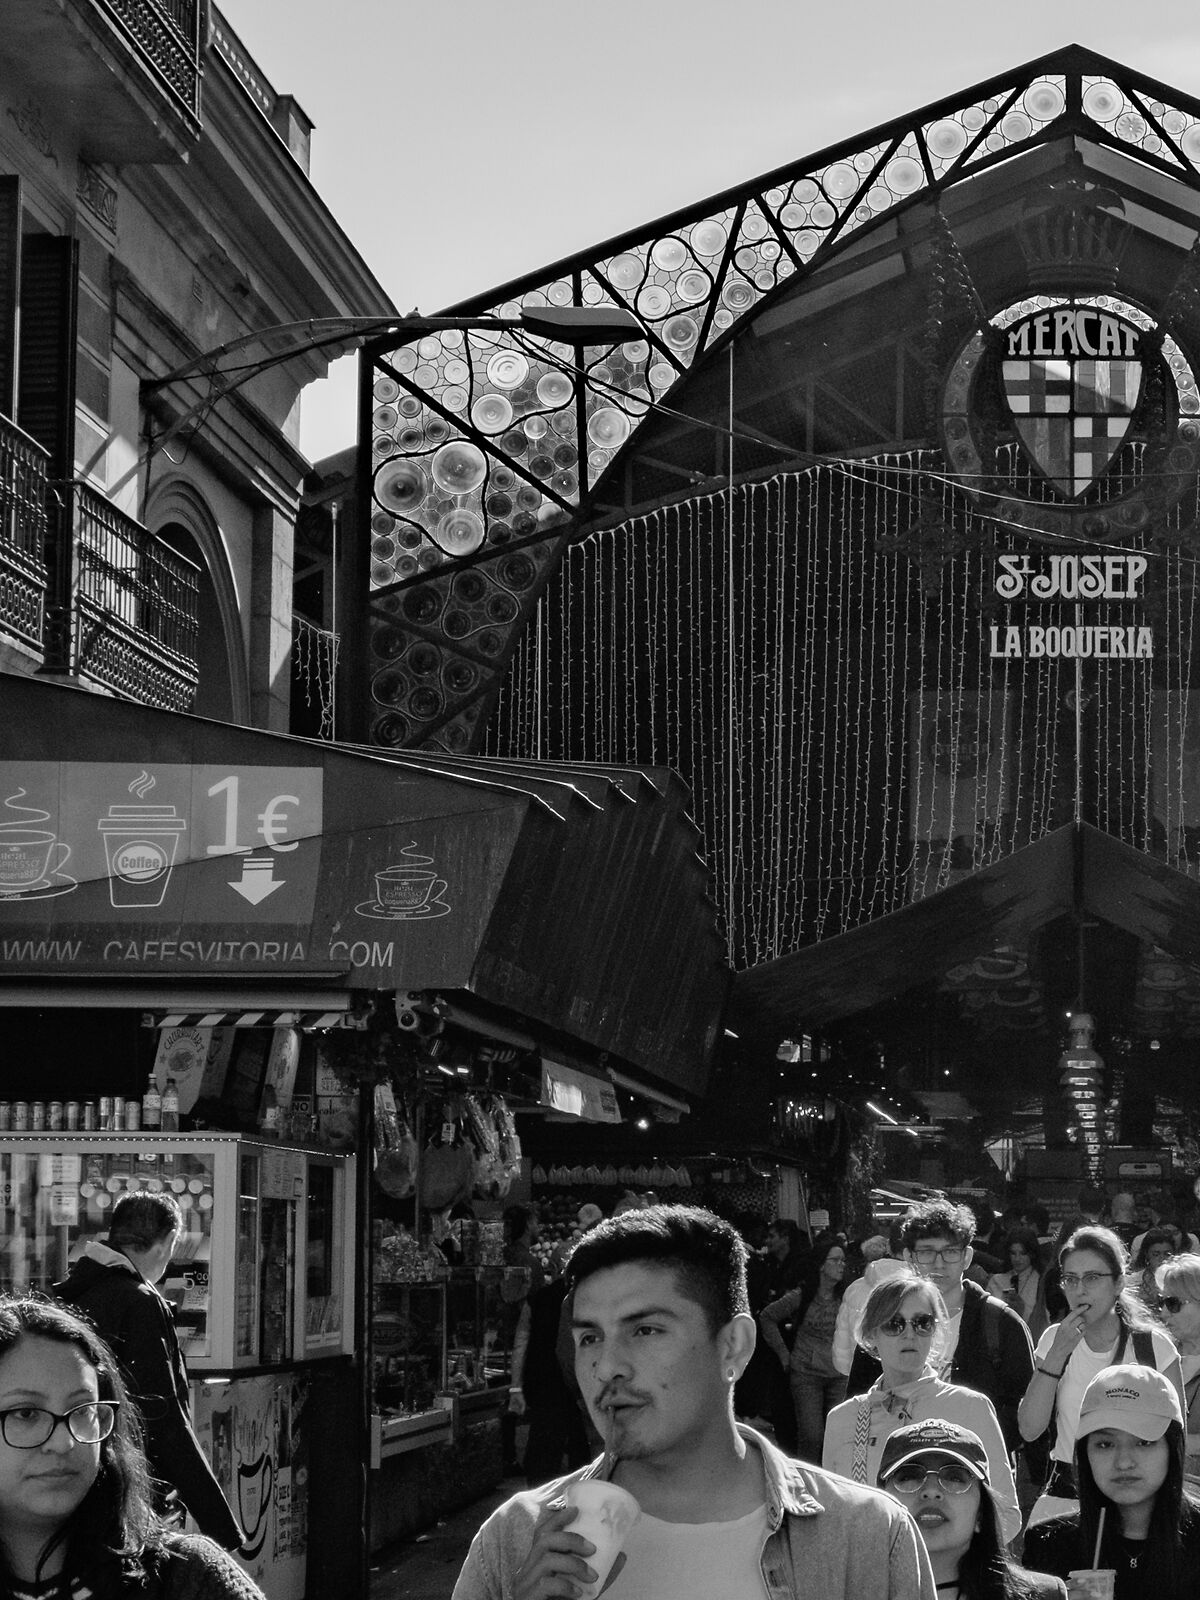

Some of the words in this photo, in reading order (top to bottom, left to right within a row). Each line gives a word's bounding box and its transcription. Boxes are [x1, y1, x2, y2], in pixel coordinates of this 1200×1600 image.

[1008, 310, 1140, 357] MERCAT
[1031, 554, 1148, 599] JOSEP
[989, 626, 1022, 658] LA
[1029, 626, 1154, 659] BOQUERIA
[120, 854, 161, 870] Coffee
[3, 940, 82, 962] WWW
[103, 940, 306, 962] CAFESVITORIA
[1105, 1387, 1140, 1398] MONACO
